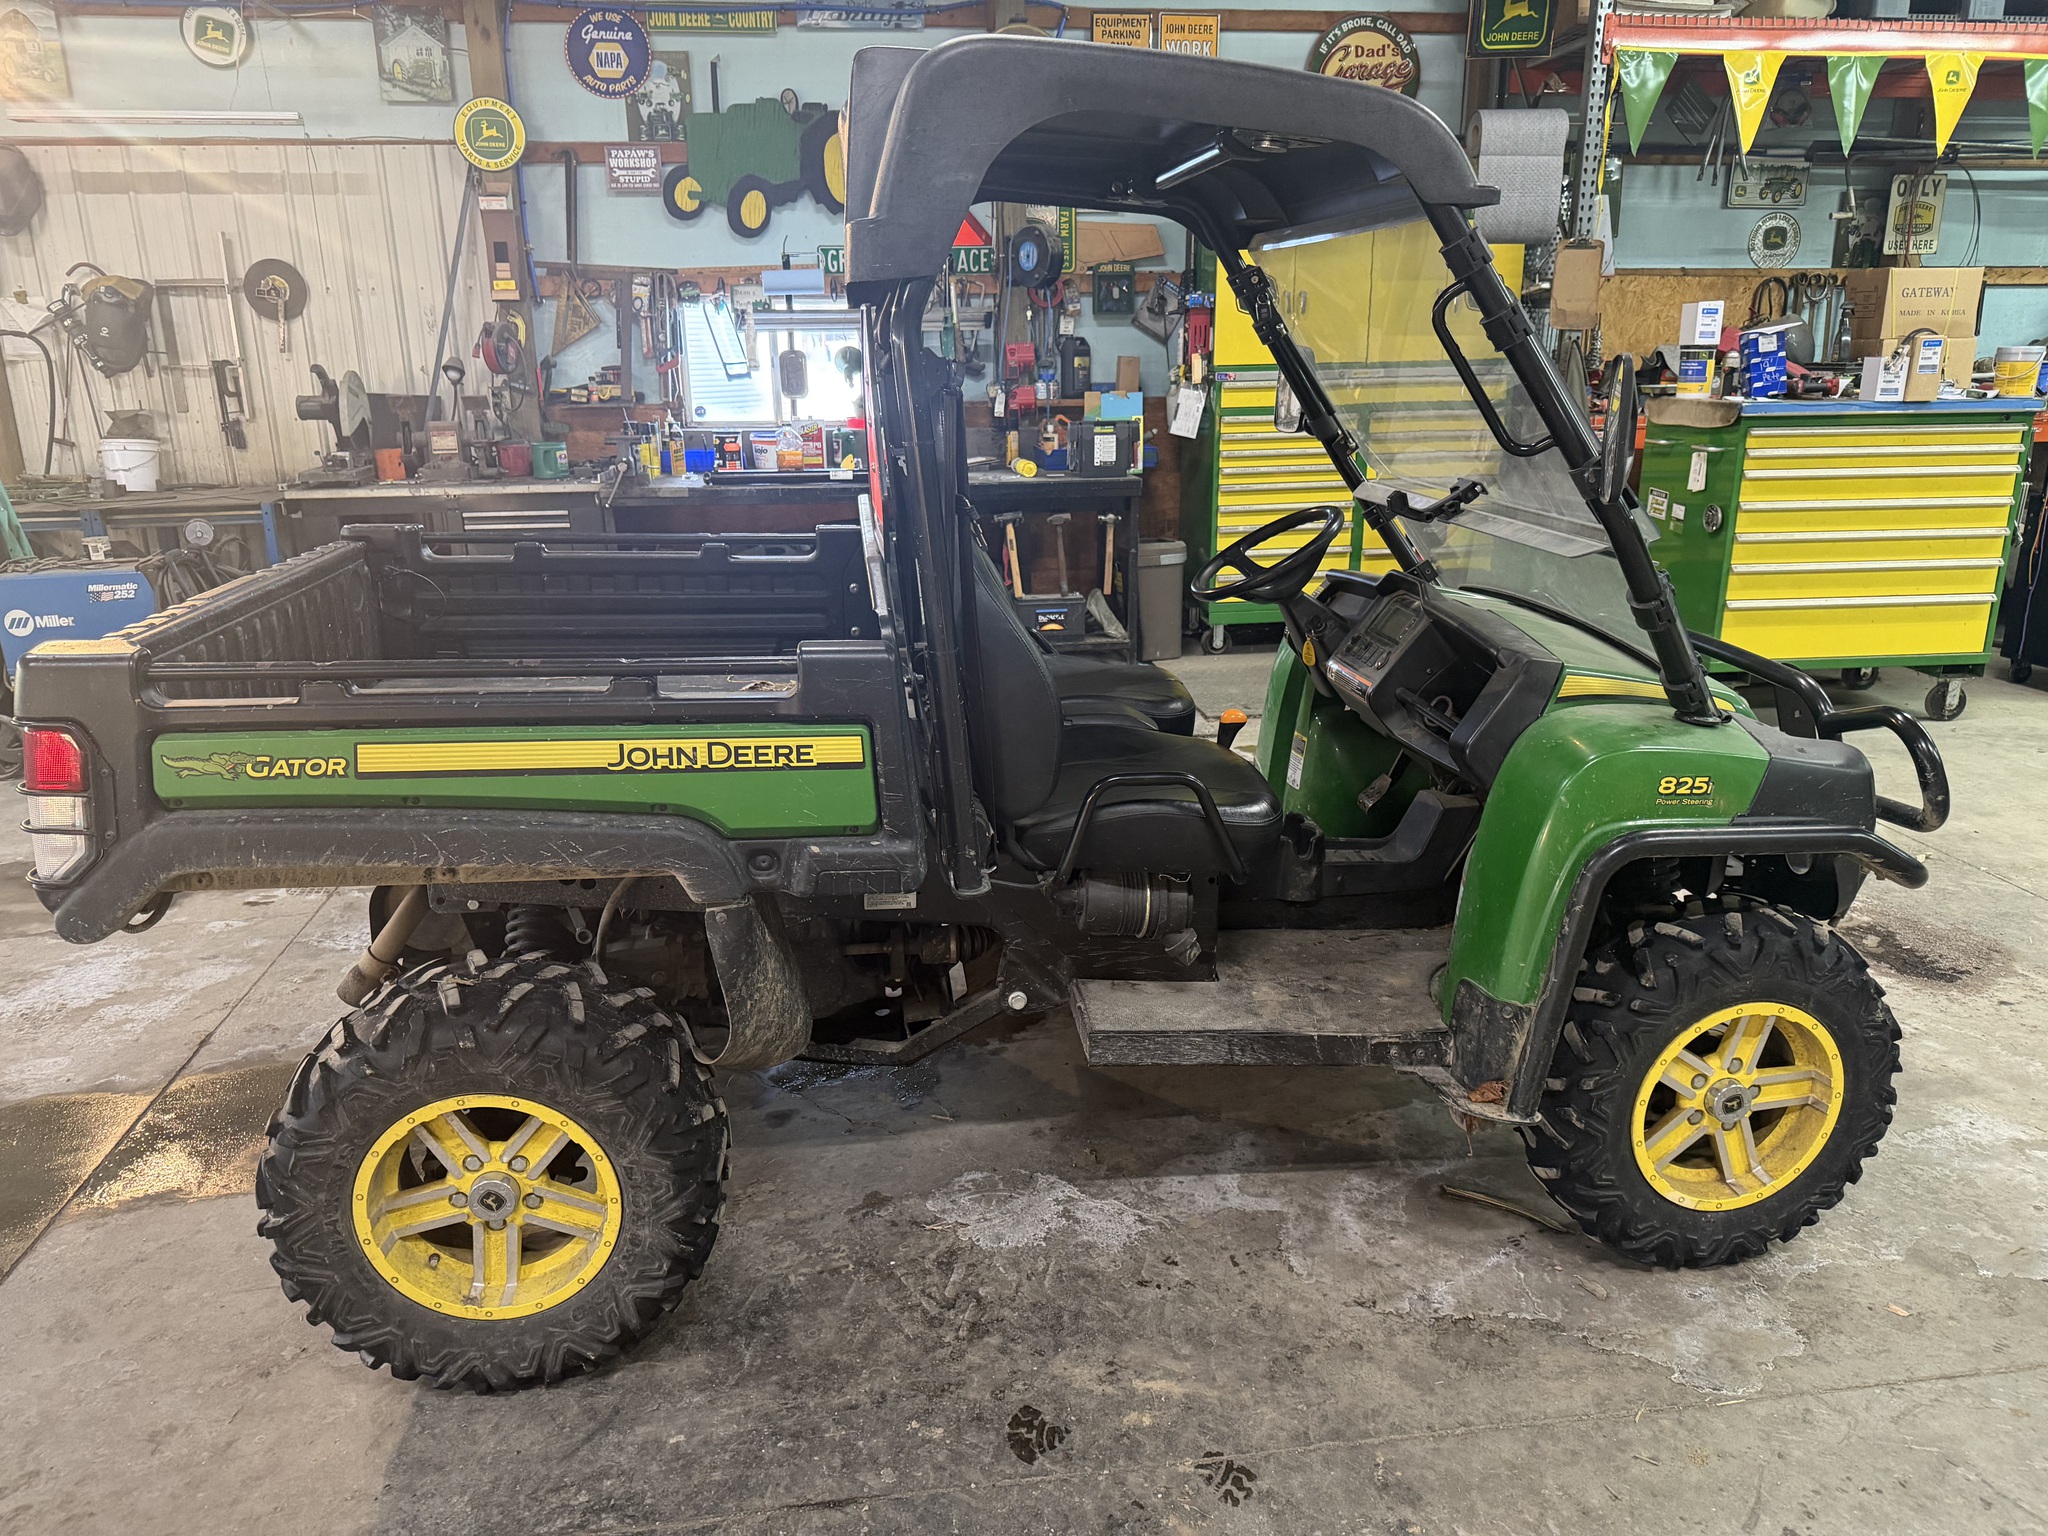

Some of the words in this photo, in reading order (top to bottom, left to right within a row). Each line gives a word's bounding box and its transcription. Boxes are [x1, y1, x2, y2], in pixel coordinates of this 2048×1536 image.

[589, 12, 603, 23] WE
[605, 12, 623, 23] USE
[649, 10, 676, 27] JOHN
[679, 11, 711, 27] DEERE
[728, 10, 774, 28] COUNTRY
[1095, 18, 1148, 28] EQUIPMENT
[581, 24, 633, 44] Genuine
[1101, 30, 1141, 39] PARKING
[1165, 23, 1185, 34] JOHN
[1188, 24, 1214, 35] DEERE
[1319, 44, 1329, 54] IF
[1326, 28, 1341, 44] IT'S
[1341, 17, 1374, 32] BROKE,
[1376, 19, 1397, 37] CALL
[1396, 33, 1411, 54] DAD
[1486, 32, 1510, 42] JOHN
[1511, 31, 1539, 41] DEERE
[197, 39, 212, 48] JOHN
[212, 44, 230, 53] DEERE
[1165, 40, 1213, 57] WORK
[1354, 43, 1400, 58] Dad's
[596, 52, 623, 69] NAPA
[1320, 44, 1415, 90] Garage
[582, 74, 607, 92] AUTO
[609, 75, 637, 93] PARTS
[461, 99, 517, 120] EQUIPMENT
[460, 142, 483, 166] PARTS
[494, 144, 522, 168] SERVICE
[610, 149, 655, 158] PAPAW'S
[609, 158, 657, 168] WORKSHOP
[1060, 211, 1069, 237] FARM
[1750, 224, 1762, 252] NOTHING
[1888, 240, 1906, 250] USE
[1912, 240, 1934, 250] HERE
[1098, 264, 1113, 273] JOHN
[1114, 263, 1131, 272] DEERE
[1901, 286, 1958, 298] GATEWAY
[87, 582, 138, 593] Millermatic
[114, 590, 135, 599] 252
[35, 615, 75, 628] Miller
[607, 743, 698, 768] JOHN
[707, 741, 815, 766] DEERE
[246, 755, 348, 778] GATOR
[1658, 776, 1713, 794] 825i
[1682, 798, 1714, 806] Steering
